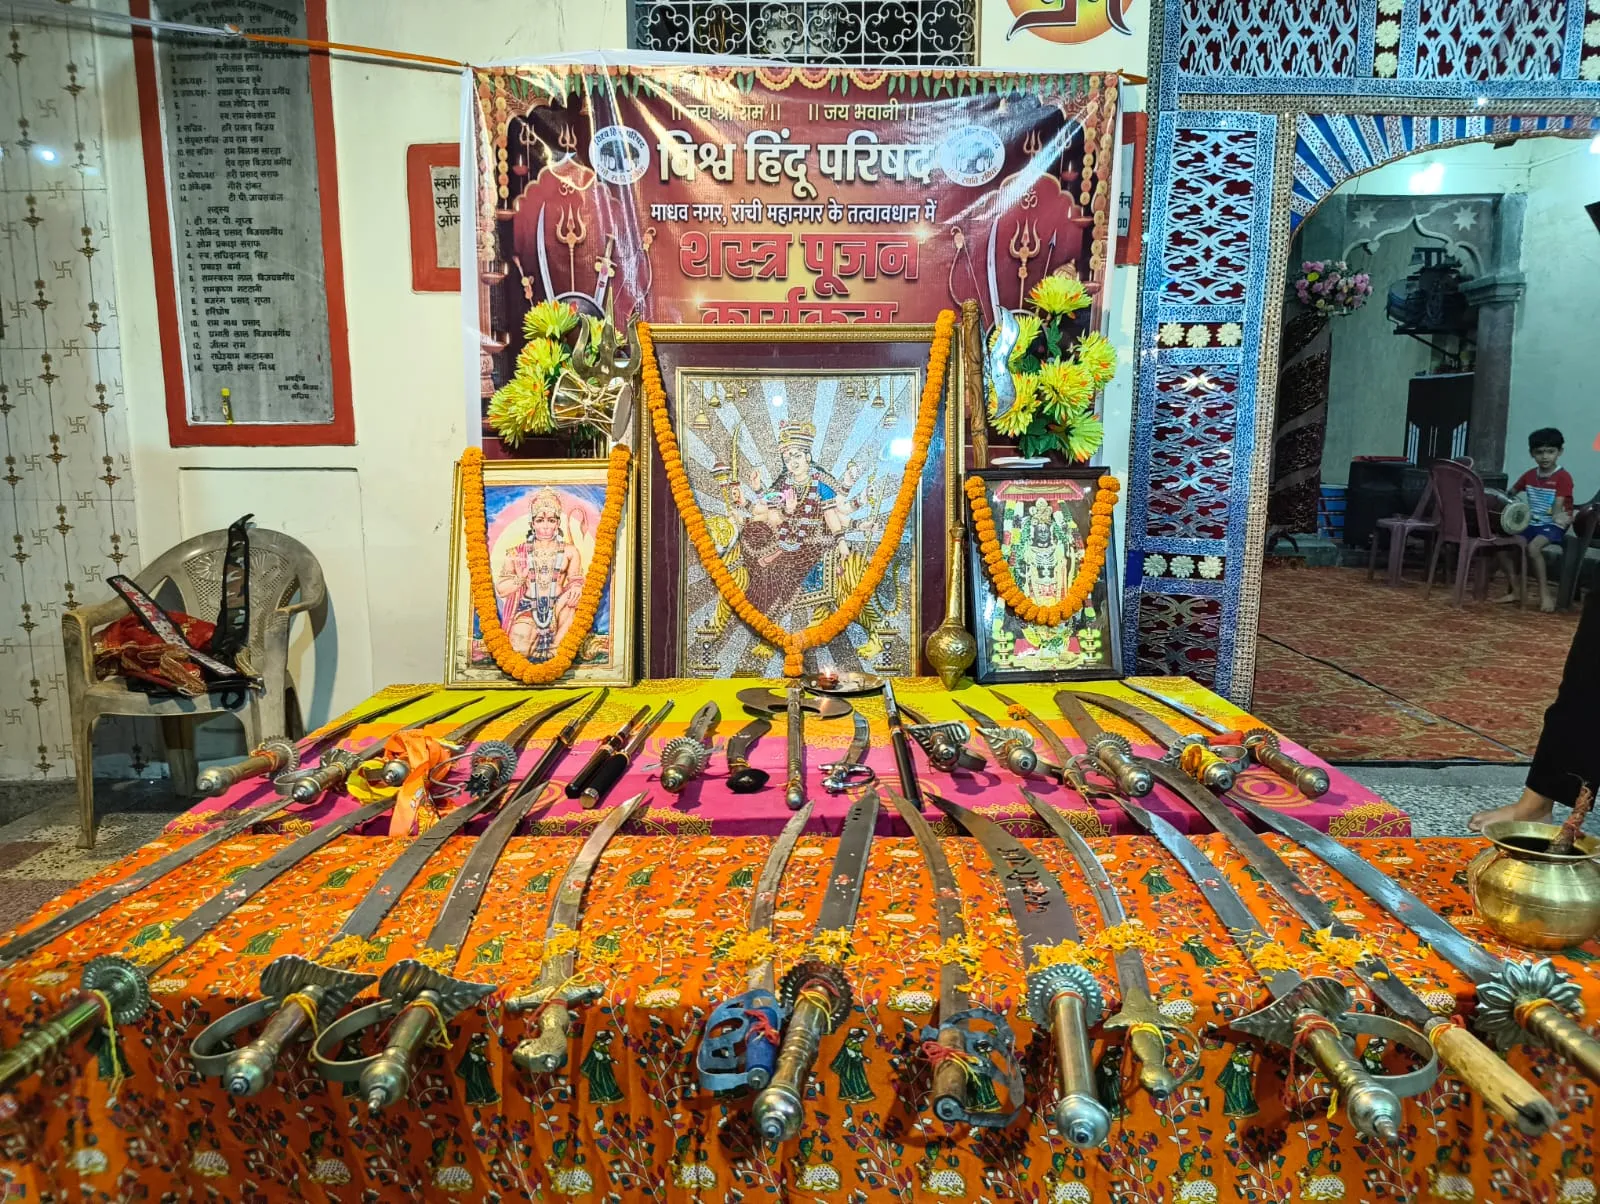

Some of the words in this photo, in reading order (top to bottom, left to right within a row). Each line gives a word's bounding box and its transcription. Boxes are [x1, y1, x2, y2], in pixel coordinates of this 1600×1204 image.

[823, 104, 849, 121] जय
[854, 98, 900, 121] भवानी
[657, 129, 737, 182] विश्व
[744, 128, 818, 198] हिंदू
[817, 130, 937, 184] परिषद
[434, 174, 460, 191] स्वर्गी
[651, 204, 688, 222] माधव
[692, 204, 728, 226] नगर,
[731, 199, 762, 222] रांची
[766, 204, 824, 224] महानगर
[828, 198, 844, 222] के
[848, 204, 920, 223] तत्वावधान
[924, 198, 938, 223] में
[679, 231, 793, 279] शस्त्र
[800, 232, 923, 296] पूजन
